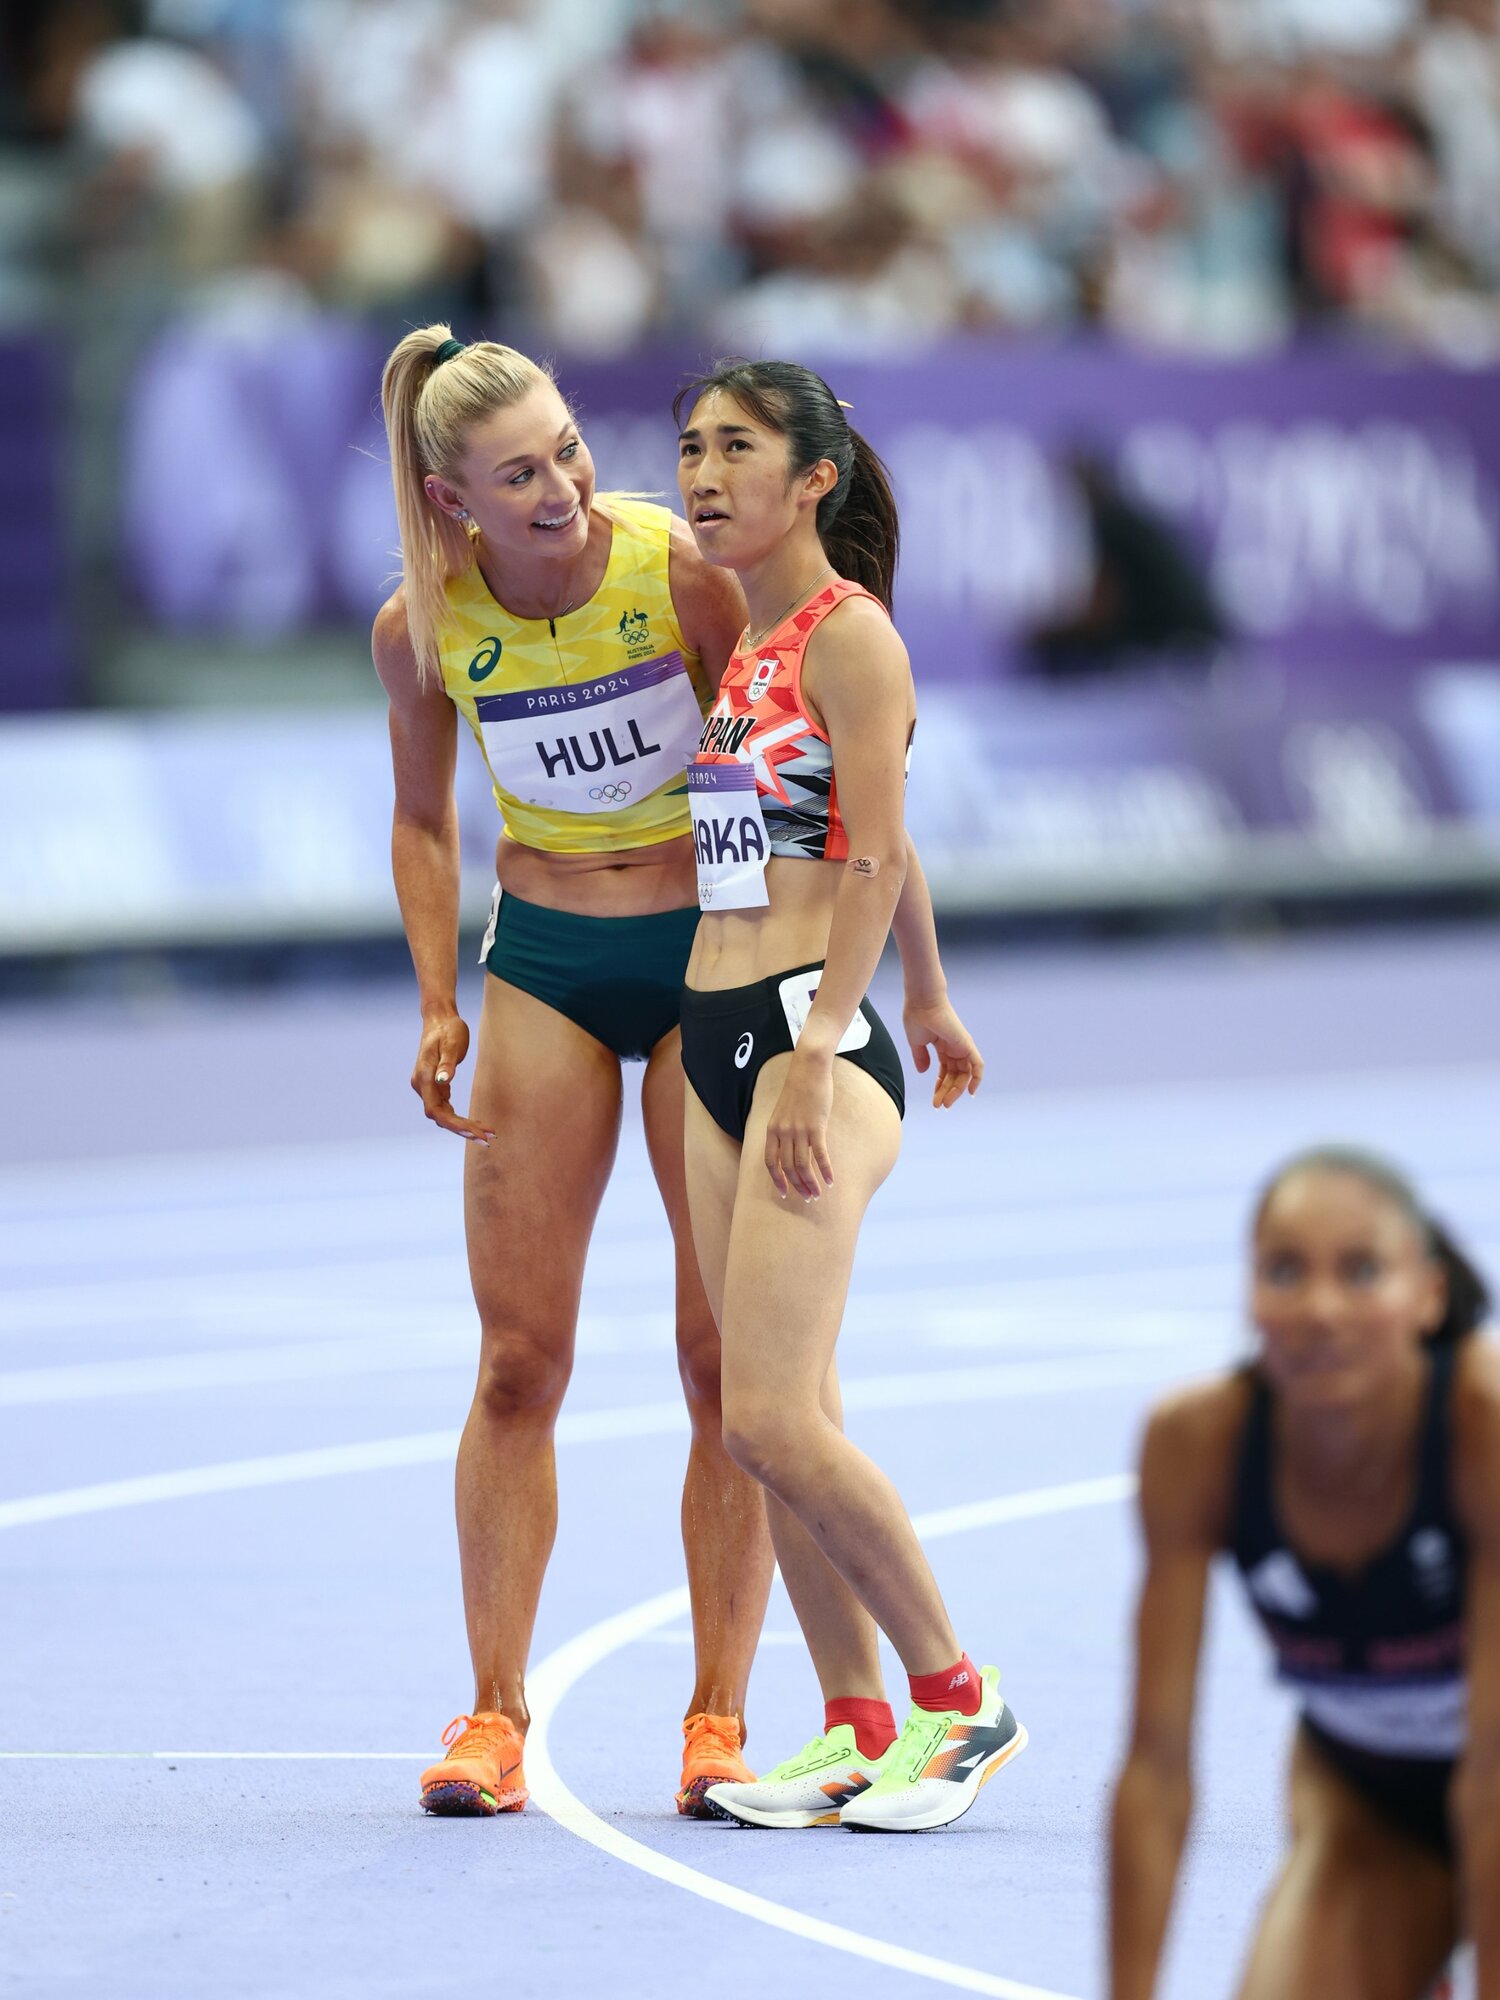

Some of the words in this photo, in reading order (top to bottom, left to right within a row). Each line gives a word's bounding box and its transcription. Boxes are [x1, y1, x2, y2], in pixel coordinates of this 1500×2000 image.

[627, 644, 655, 654] AUSTRALIA
[582, 677, 630, 700] 2024
[535, 718, 662, 778] HULL
[698, 716, 757, 754] APAN
